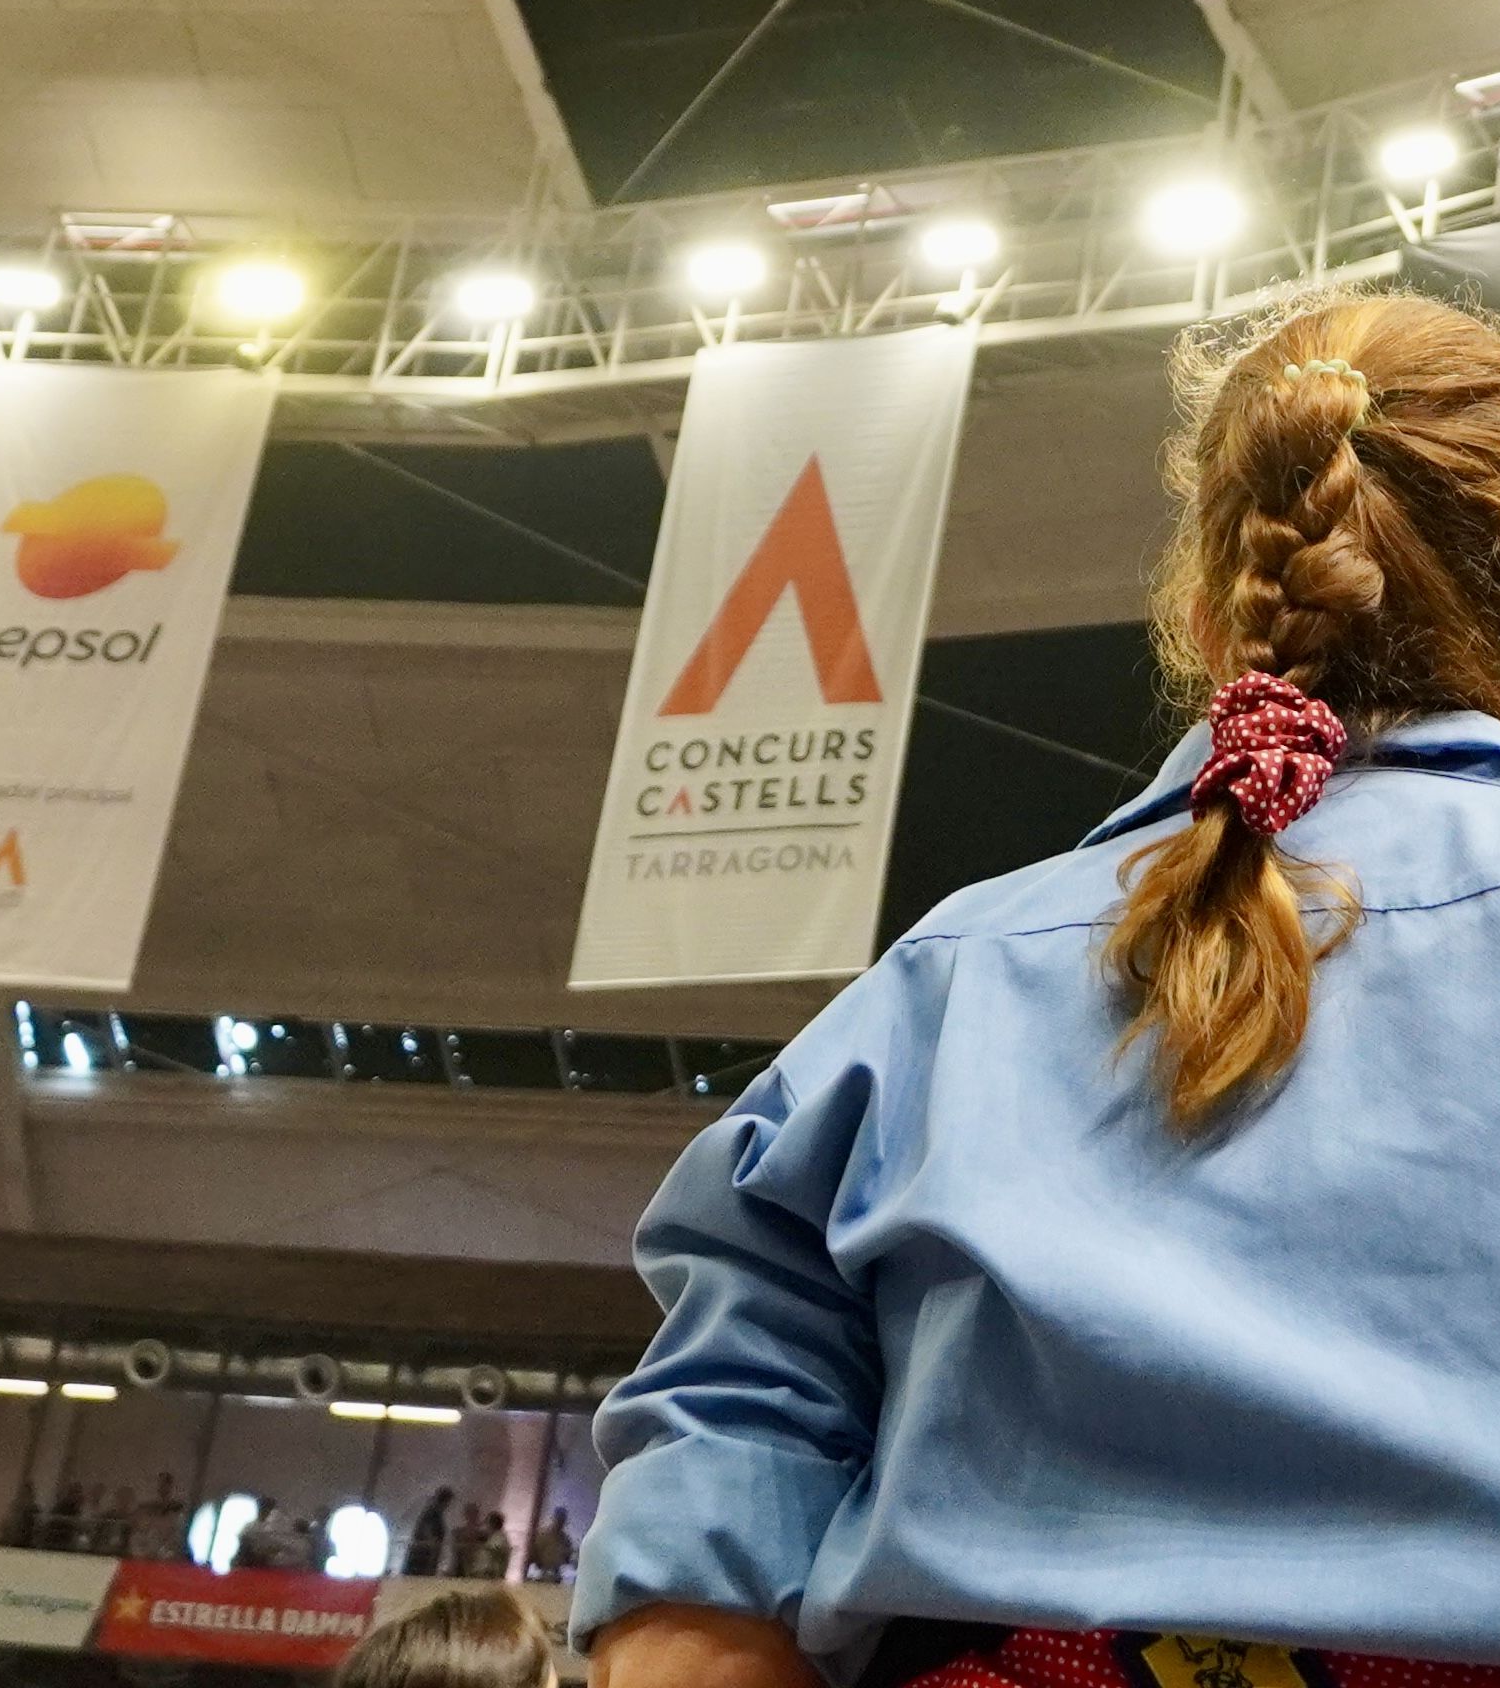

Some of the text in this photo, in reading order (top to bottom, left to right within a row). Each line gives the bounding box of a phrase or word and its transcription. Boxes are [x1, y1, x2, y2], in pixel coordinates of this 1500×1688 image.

[646, 728, 876, 772] CONCURS
[636, 773, 868, 817] CASTELLS
[625, 842, 857, 881] TARRAGONA
[151, 1600, 276, 1634] ESTRELLA
